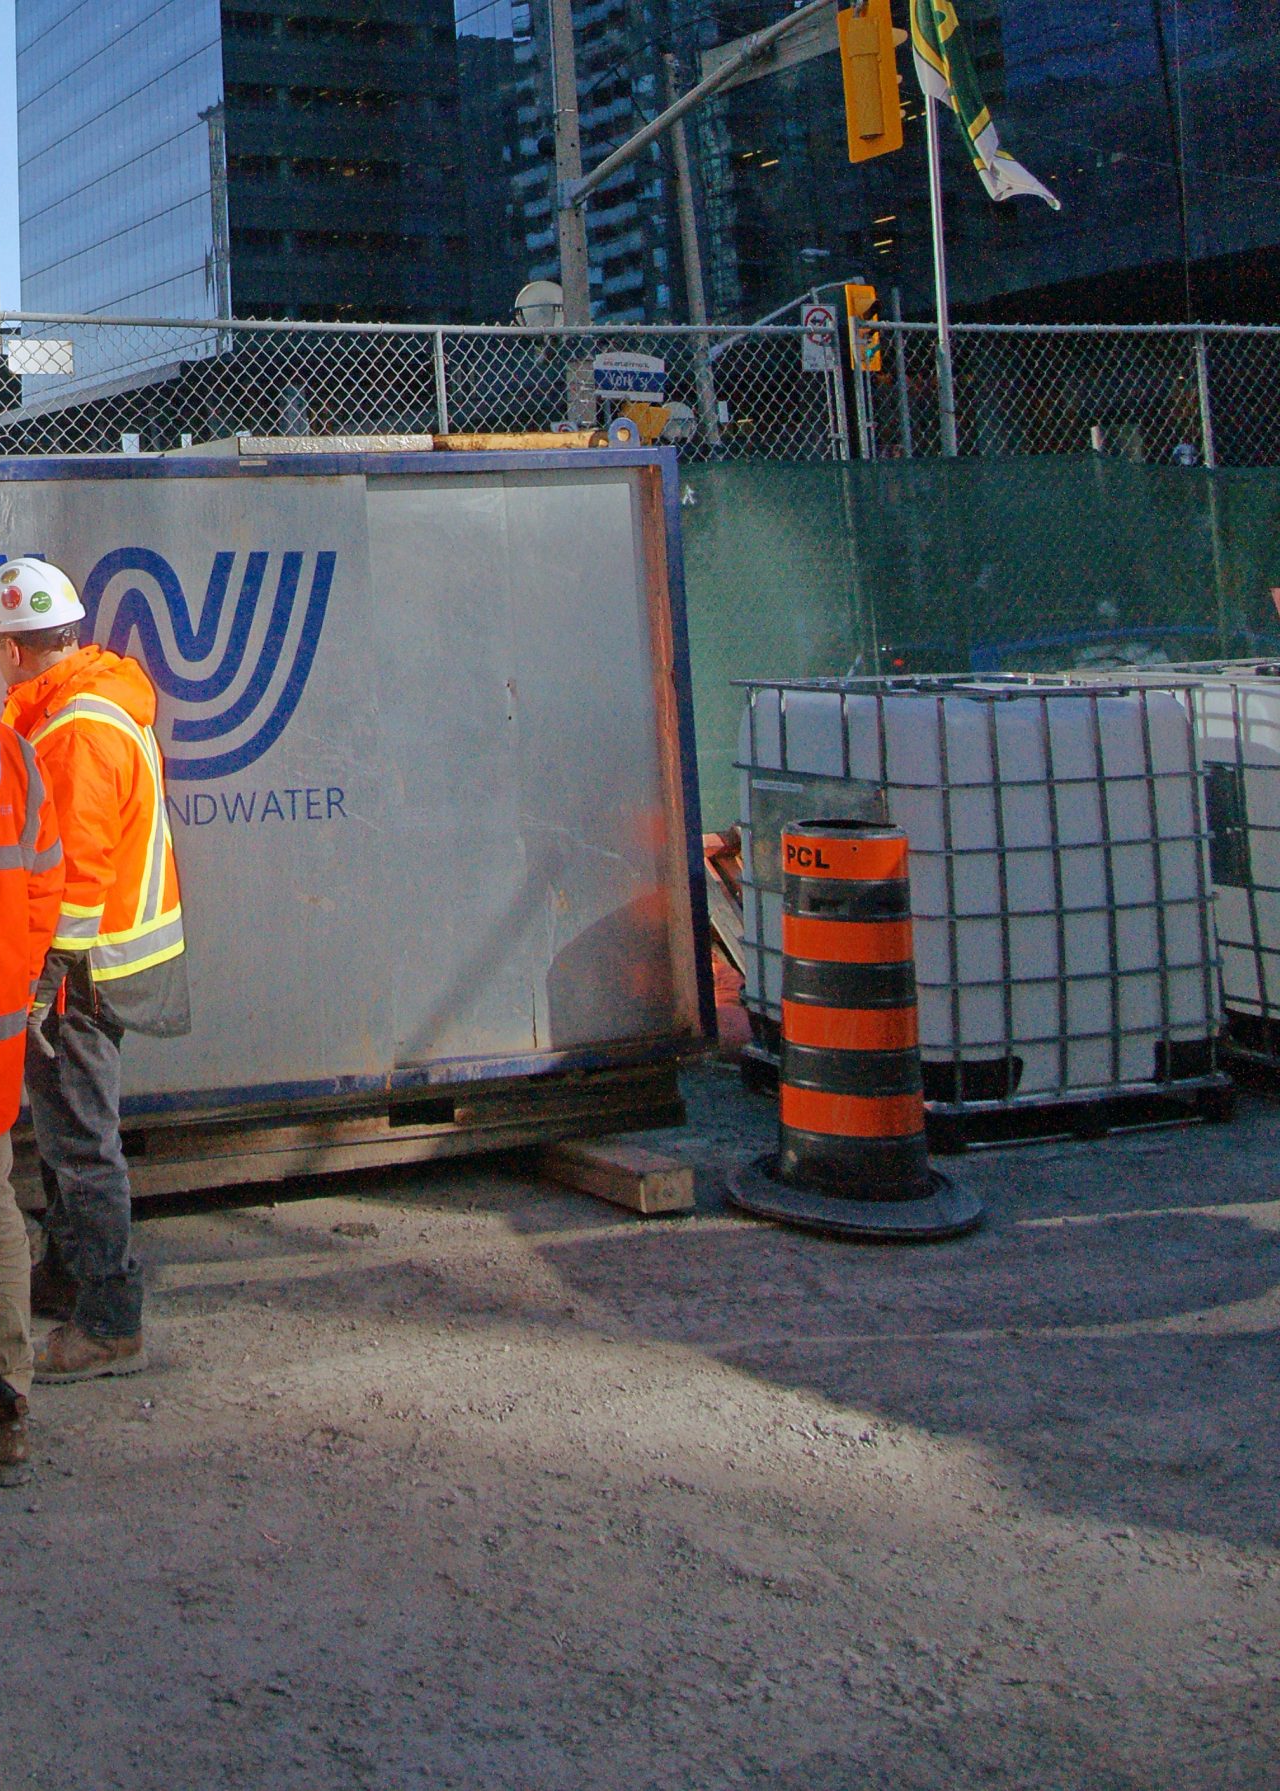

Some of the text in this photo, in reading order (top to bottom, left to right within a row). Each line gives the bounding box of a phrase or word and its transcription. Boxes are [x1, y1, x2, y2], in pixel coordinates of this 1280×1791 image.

[609, 373, 634, 387] York
[166, 787, 348, 826] NDWATER
[786, 844, 830, 869] PCL
